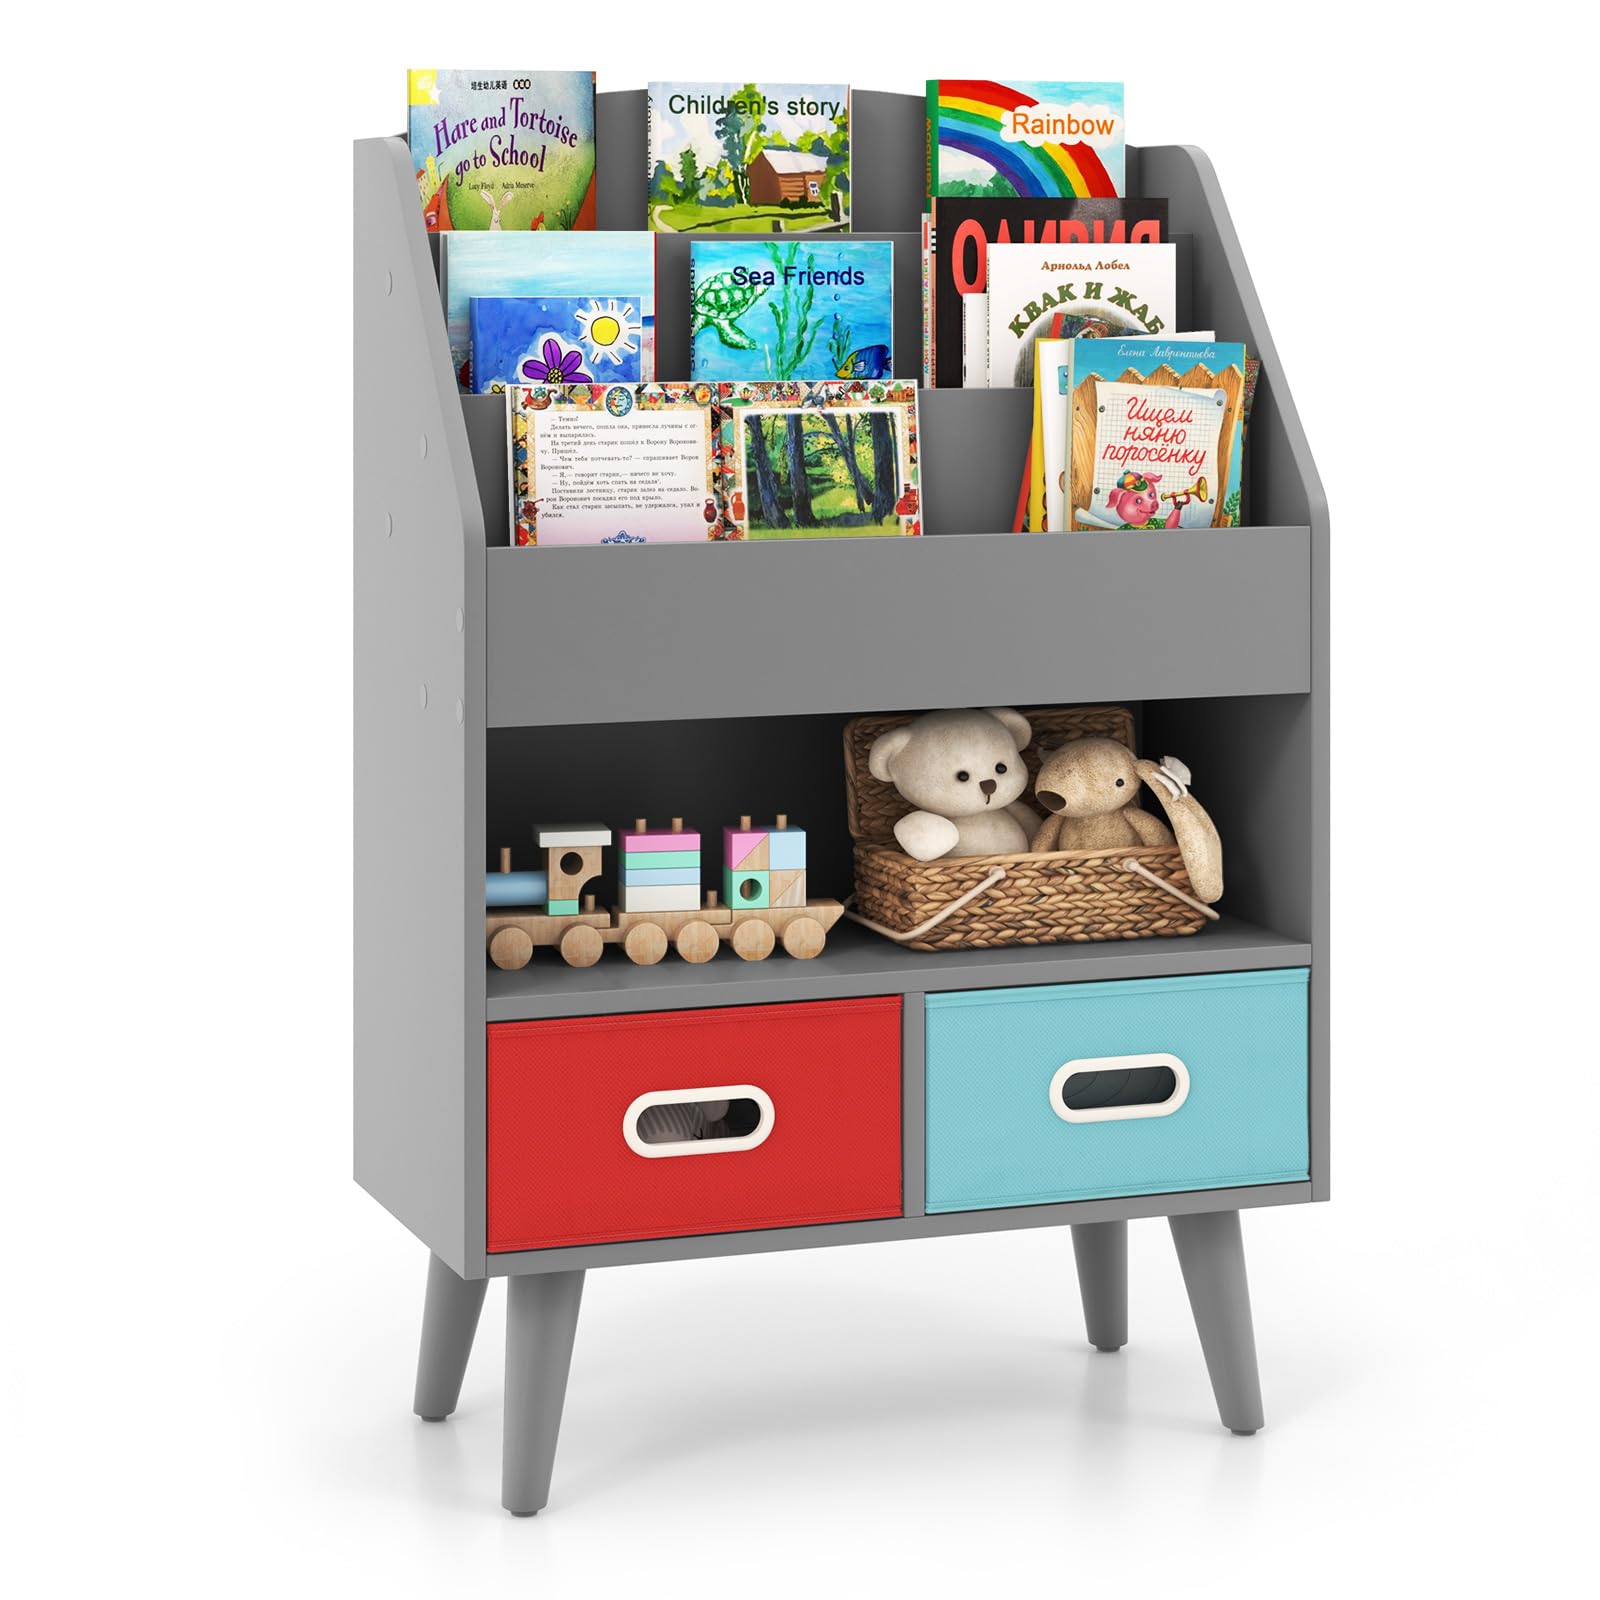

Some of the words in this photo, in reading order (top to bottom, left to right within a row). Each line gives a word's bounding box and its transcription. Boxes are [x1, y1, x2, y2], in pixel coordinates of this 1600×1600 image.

[668, 94, 779, 116] Children's
[787, 97, 841, 121] story
[433, 117, 478, 157] Hare
[481, 107, 506, 132] and
[509, 97, 578, 148] Tortoise
[1012, 113, 1115, 136] Rainbow
[455, 158, 470, 187] go
[473, 150, 486, 169] to
[489, 134, 546, 172] School
[733, 266, 775, 286] Sea
[784, 266, 865, 286] Friends
[1041, 260, 1092, 272] Арнольд
[1095, 259, 1130, 271] Лобел
[1008, 283, 1077, 339] КВАК
[1083, 282, 1103, 299] И
[1107, 287, 1165, 334] ЖАБ
[1118, 344, 1146, 357] Елена
[1150, 345, 1216, 361] Лаврентьева
[1127, 397, 1193, 427] Ищем
[1123, 426, 1186, 445] няню
[1102, 443, 1207, 476] поросёнку
